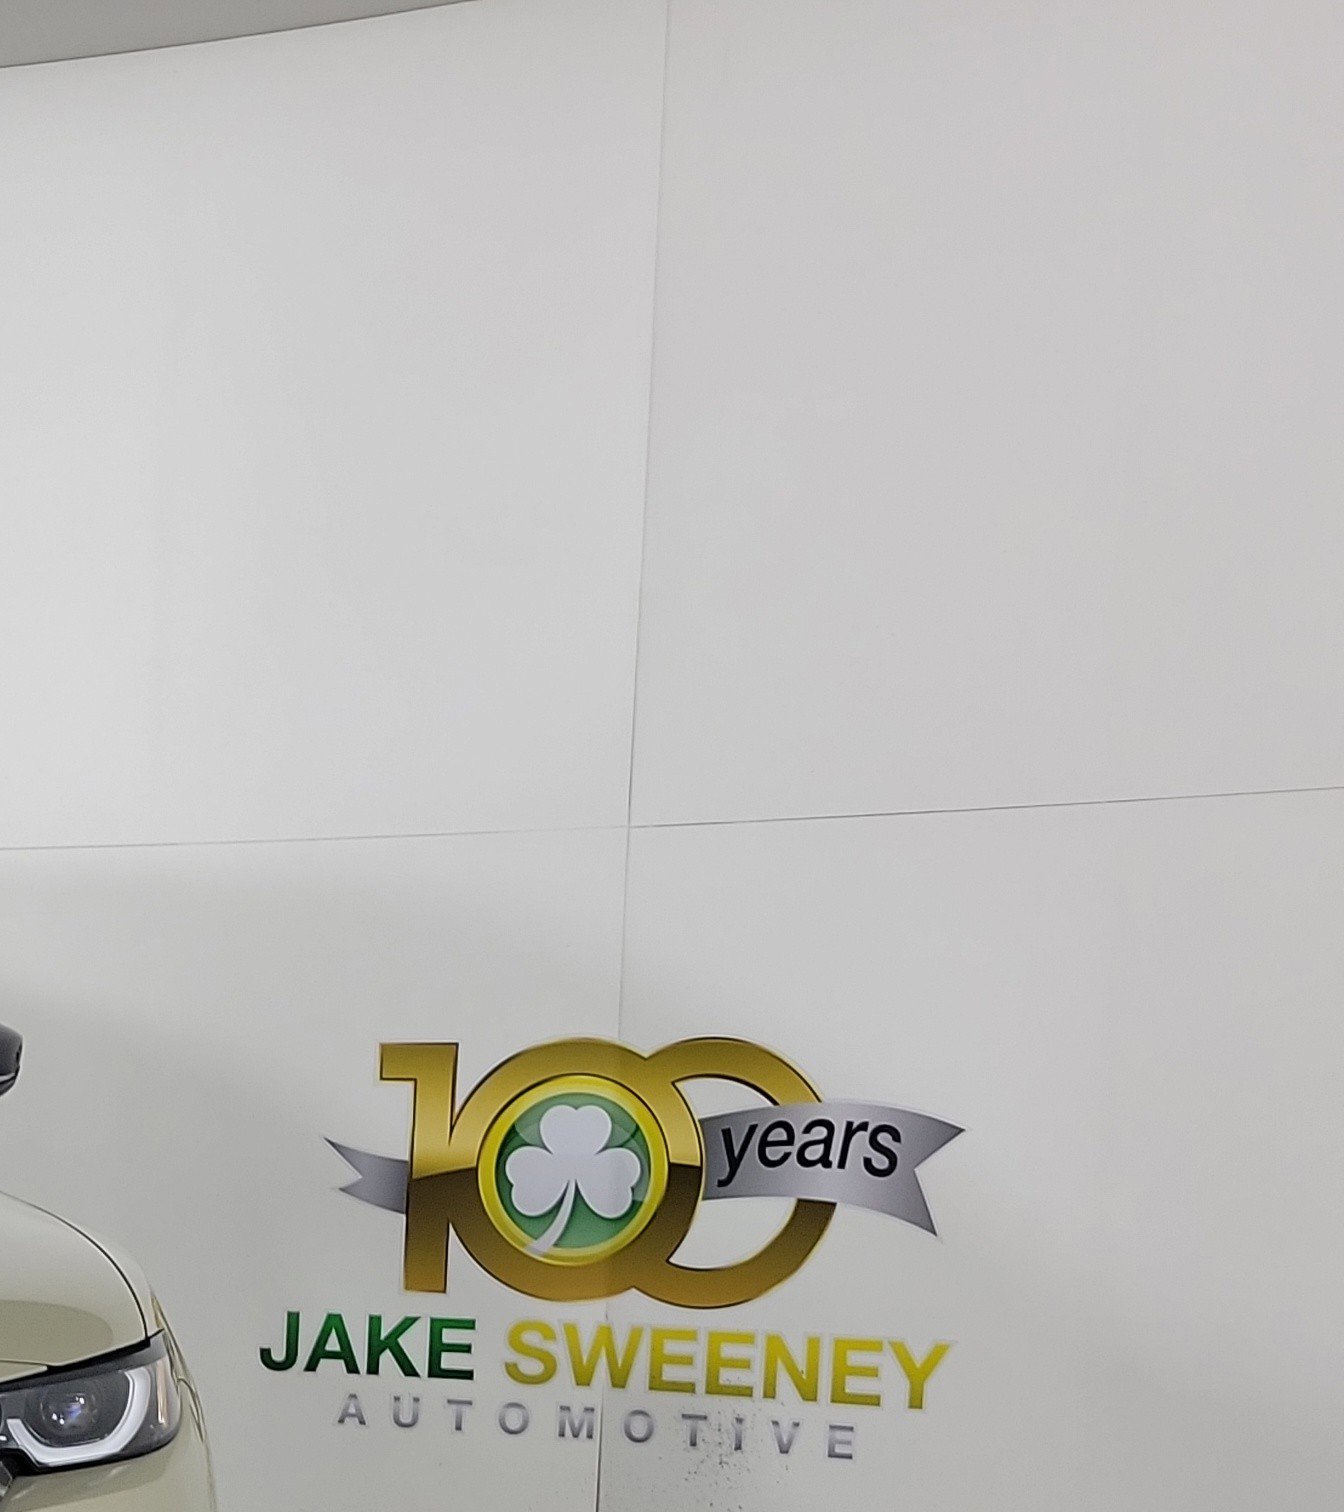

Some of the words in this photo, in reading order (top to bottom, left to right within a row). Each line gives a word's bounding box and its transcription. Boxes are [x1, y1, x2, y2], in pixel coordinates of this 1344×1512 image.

[379, 1037, 838, 1309] 100
[716, 1118, 902, 1187] years
[259, 1311, 476, 1380] JAKE
[504, 1320, 952, 1410] SWEENEY
[337, 1393, 856, 1460] AUTOMOTIVE
